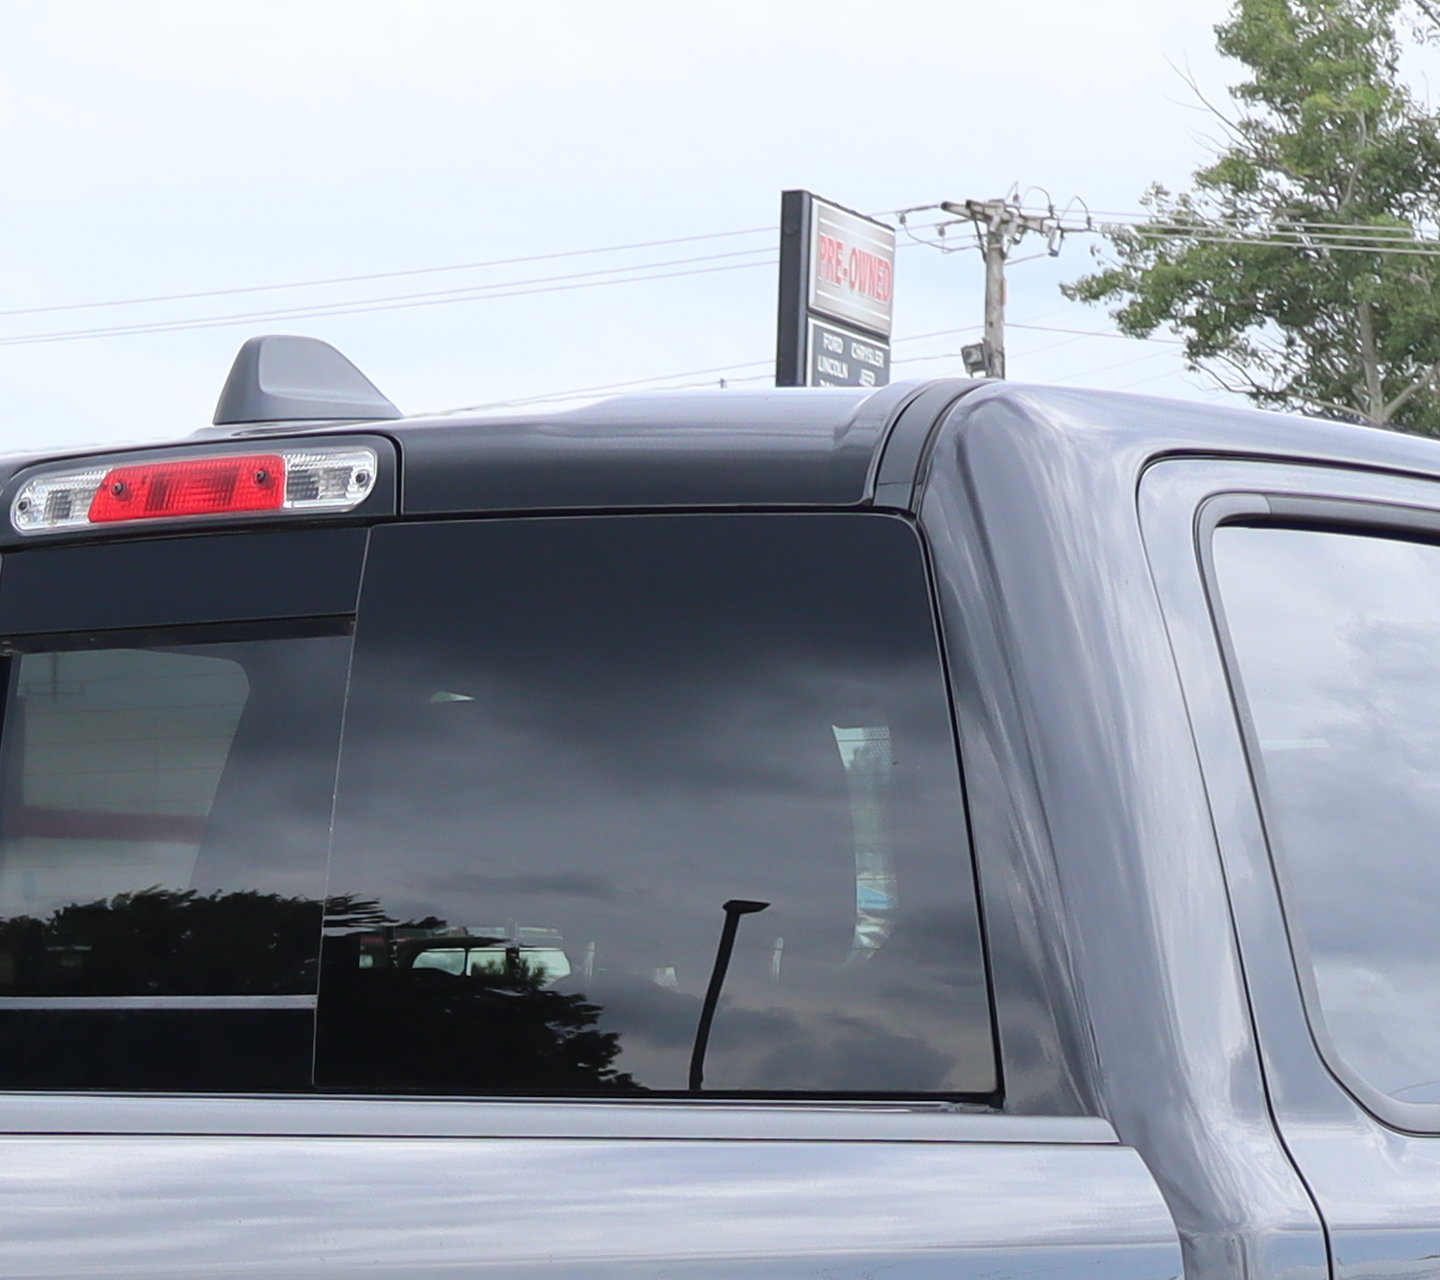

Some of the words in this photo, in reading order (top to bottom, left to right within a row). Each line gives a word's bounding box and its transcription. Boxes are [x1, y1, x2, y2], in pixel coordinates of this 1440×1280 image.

[819, 236, 893, 303] PRE-OWNED
[822, 331, 845, 354] FORD
[851, 341, 885, 368] CHRYSLER
[817, 354, 849, 380] LINCOLN
